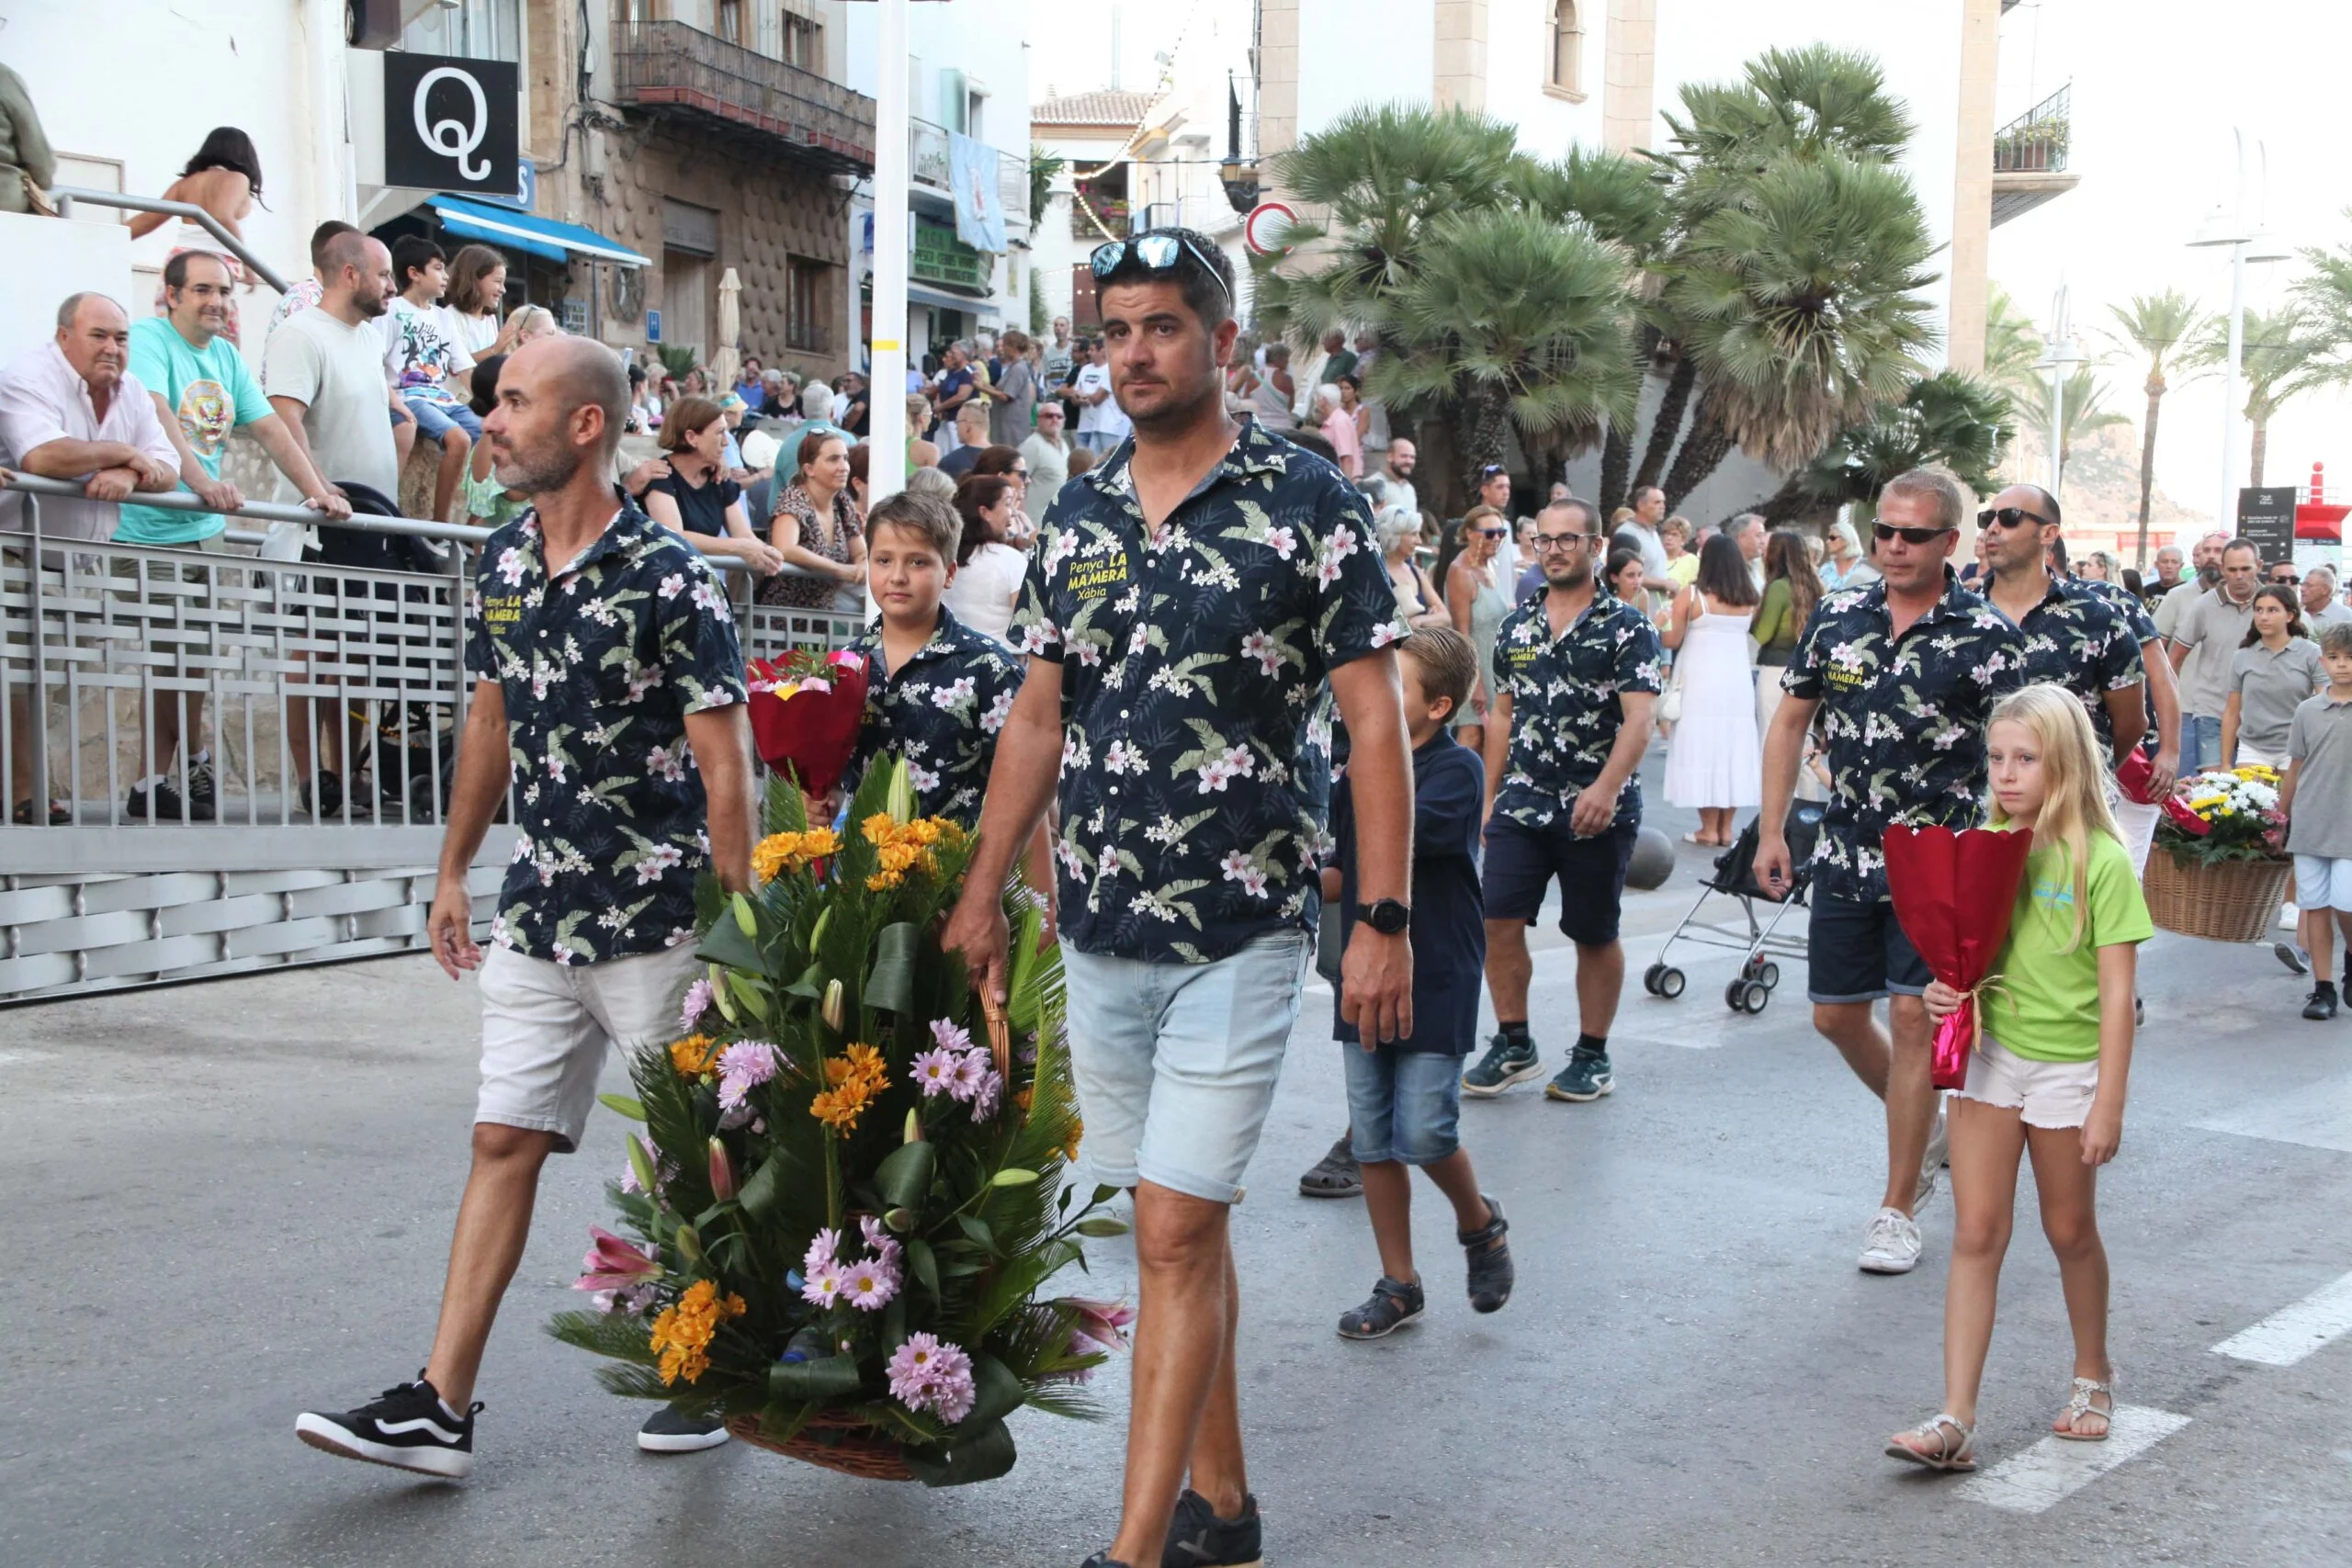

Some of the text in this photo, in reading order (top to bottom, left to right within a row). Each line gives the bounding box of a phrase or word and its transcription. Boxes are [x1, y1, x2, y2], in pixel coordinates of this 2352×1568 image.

[413, 66, 492, 181] Q
[1069, 552, 1127, 575] Penya LA
[1068, 567, 1127, 592] MAMERA
[507, 594, 521, 607] LA
[1077, 587, 1106, 602] Xàbia
